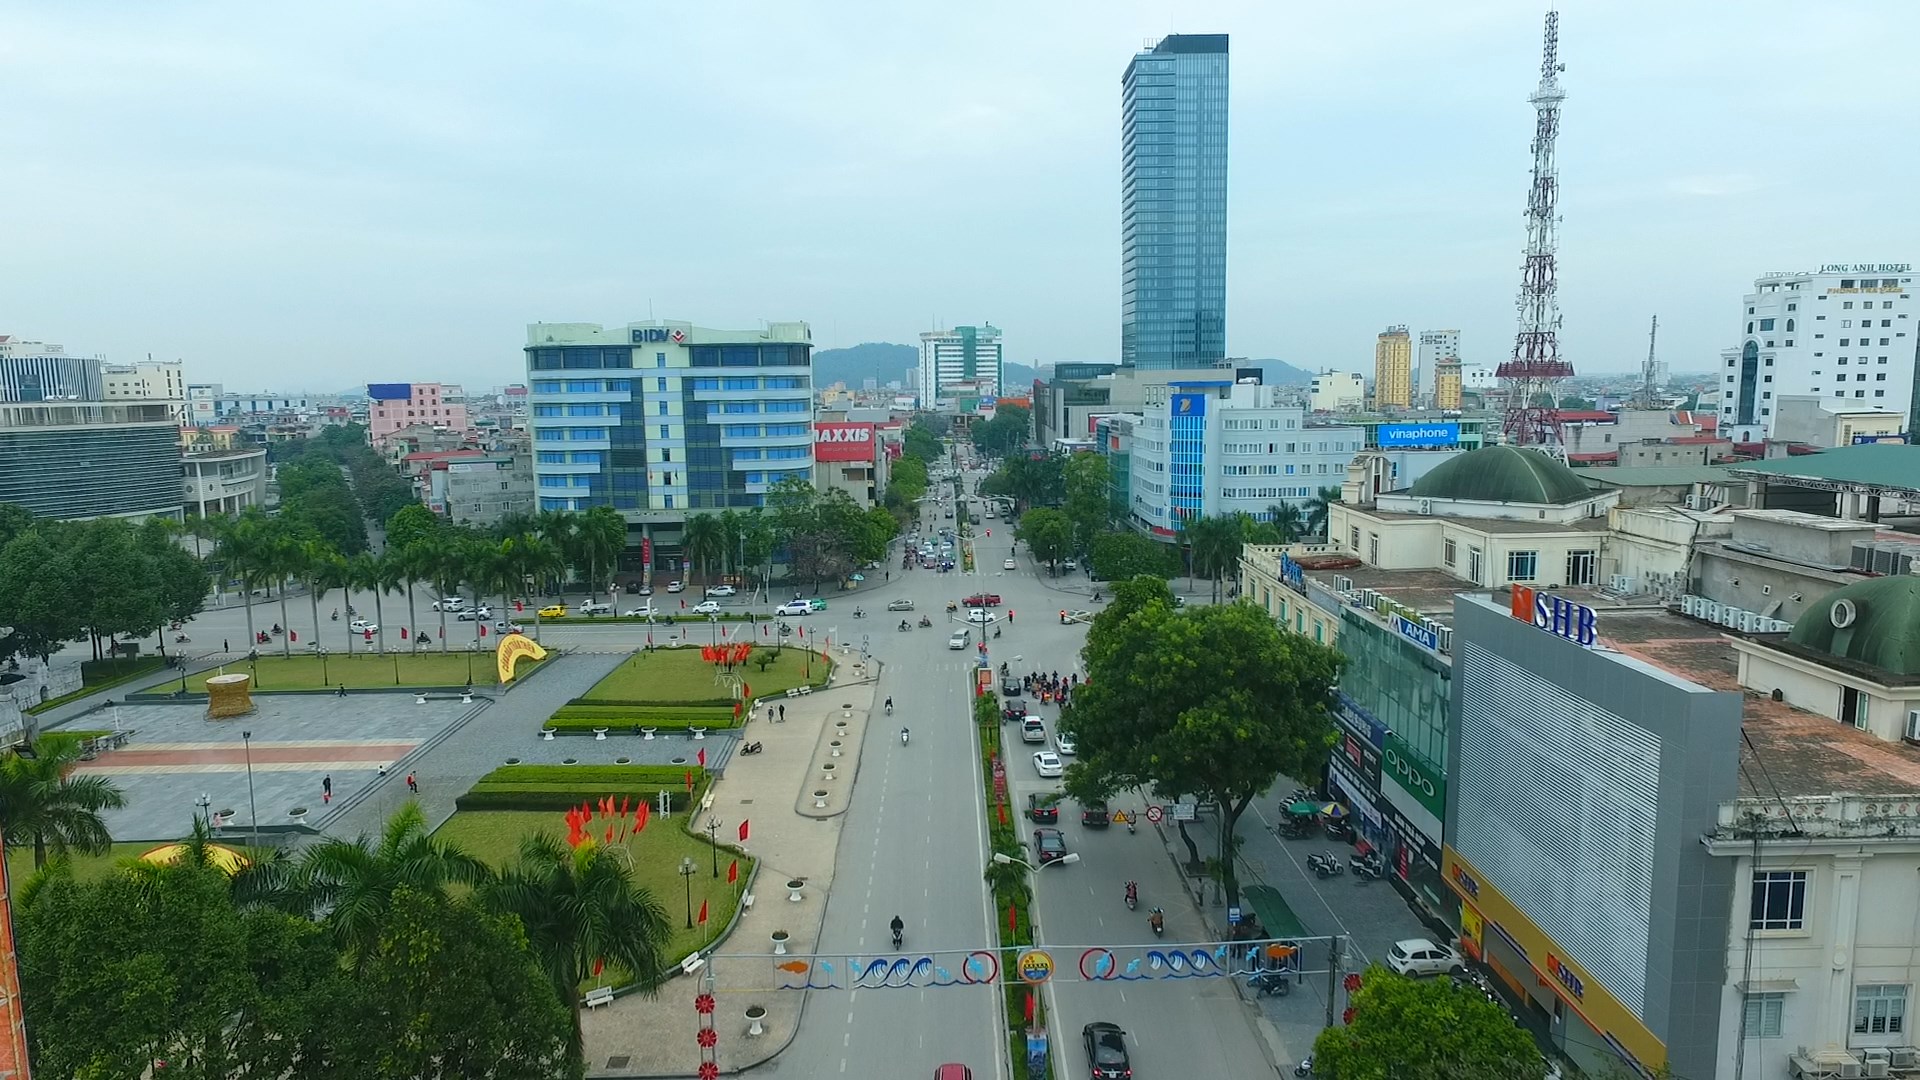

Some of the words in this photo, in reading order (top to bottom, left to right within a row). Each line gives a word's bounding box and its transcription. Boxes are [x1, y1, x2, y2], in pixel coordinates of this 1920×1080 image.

[1820, 264, 1849, 273] LONG
[1852, 264, 1876, 272] ANH
[1878, 263, 1913, 272] HOTEL
[632, 328, 670, 342] BIDV
[1388, 427, 1449, 440] vinaphone
[1534, 591, 1597, 646] SHB
[1405, 623, 1431, 646] AMA
[1558, 961, 1584, 998] SHB
